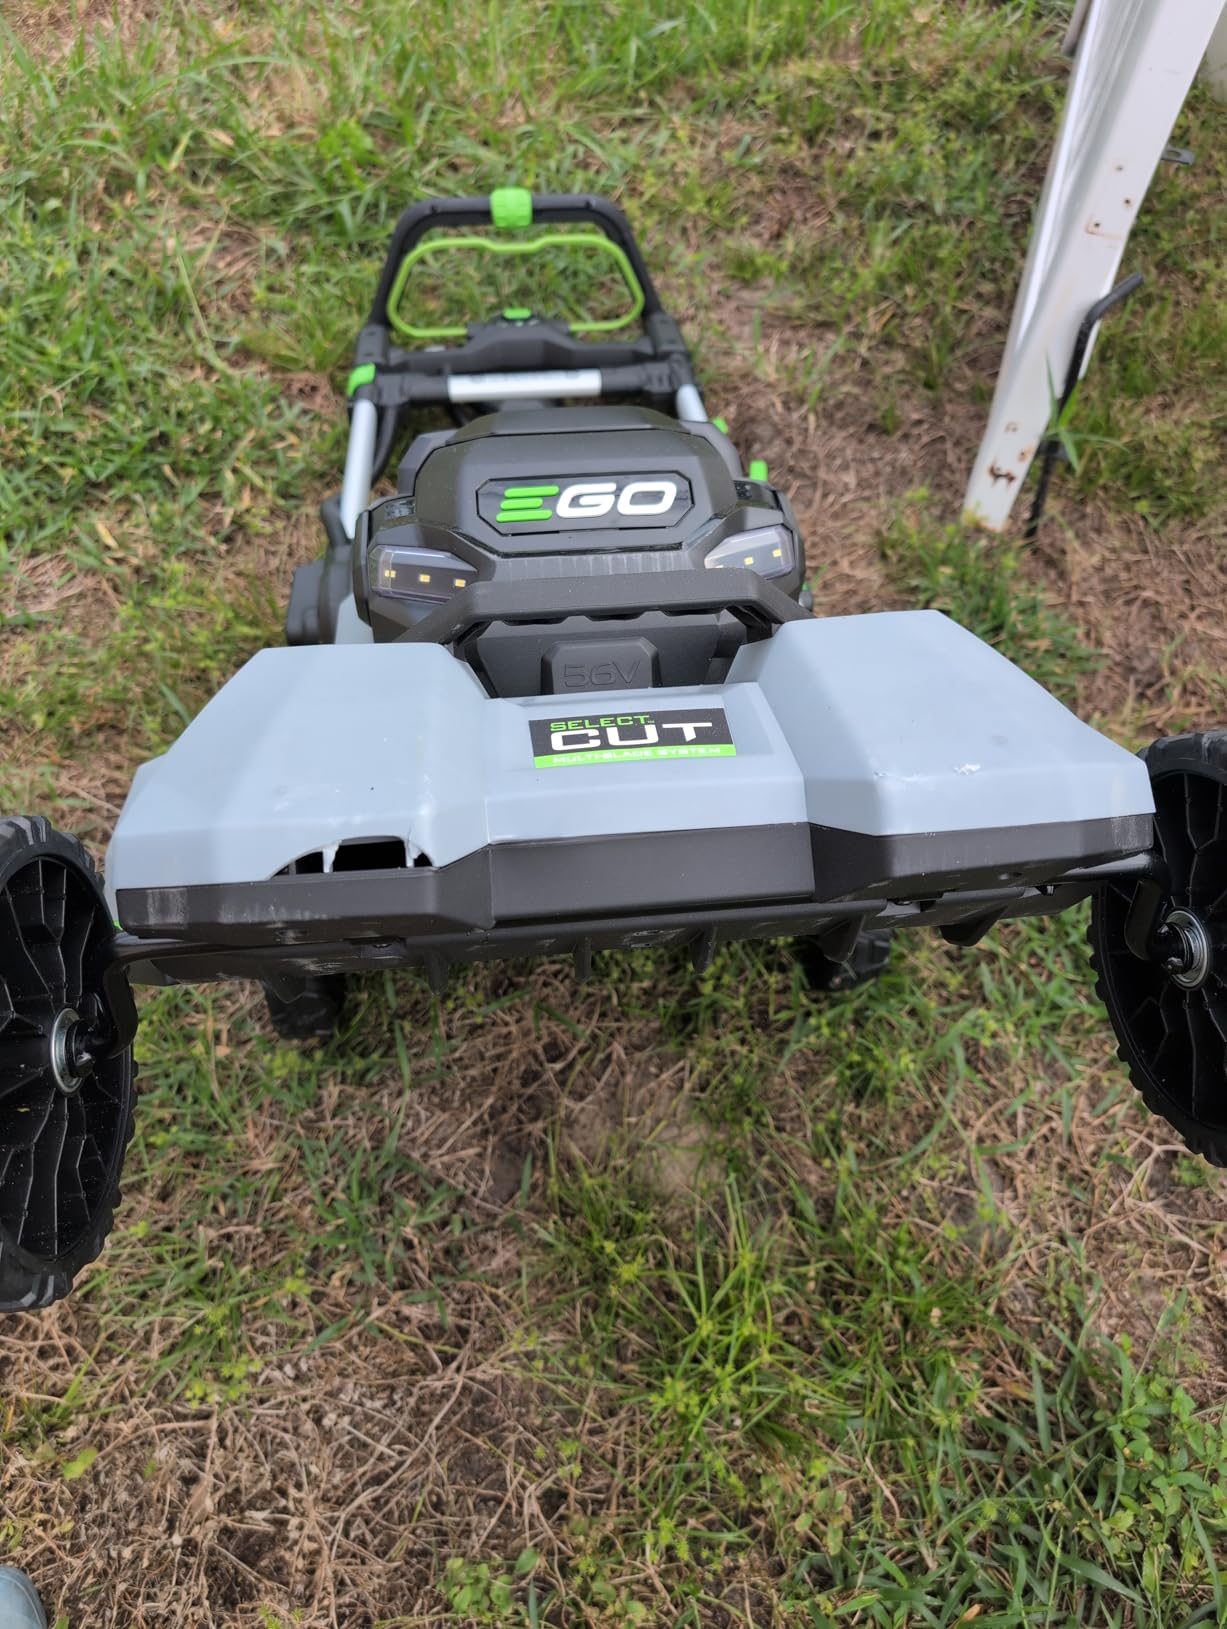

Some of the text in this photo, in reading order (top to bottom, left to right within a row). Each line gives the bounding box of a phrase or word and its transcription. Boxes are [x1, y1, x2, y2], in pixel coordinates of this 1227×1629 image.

[496, 481, 677, 523] EGO
[563, 661, 641, 688] 56V
[550, 715, 650, 731] SELECT
[551, 722, 712, 750] CUT
[656, 747, 721, 756] SYSTEM
